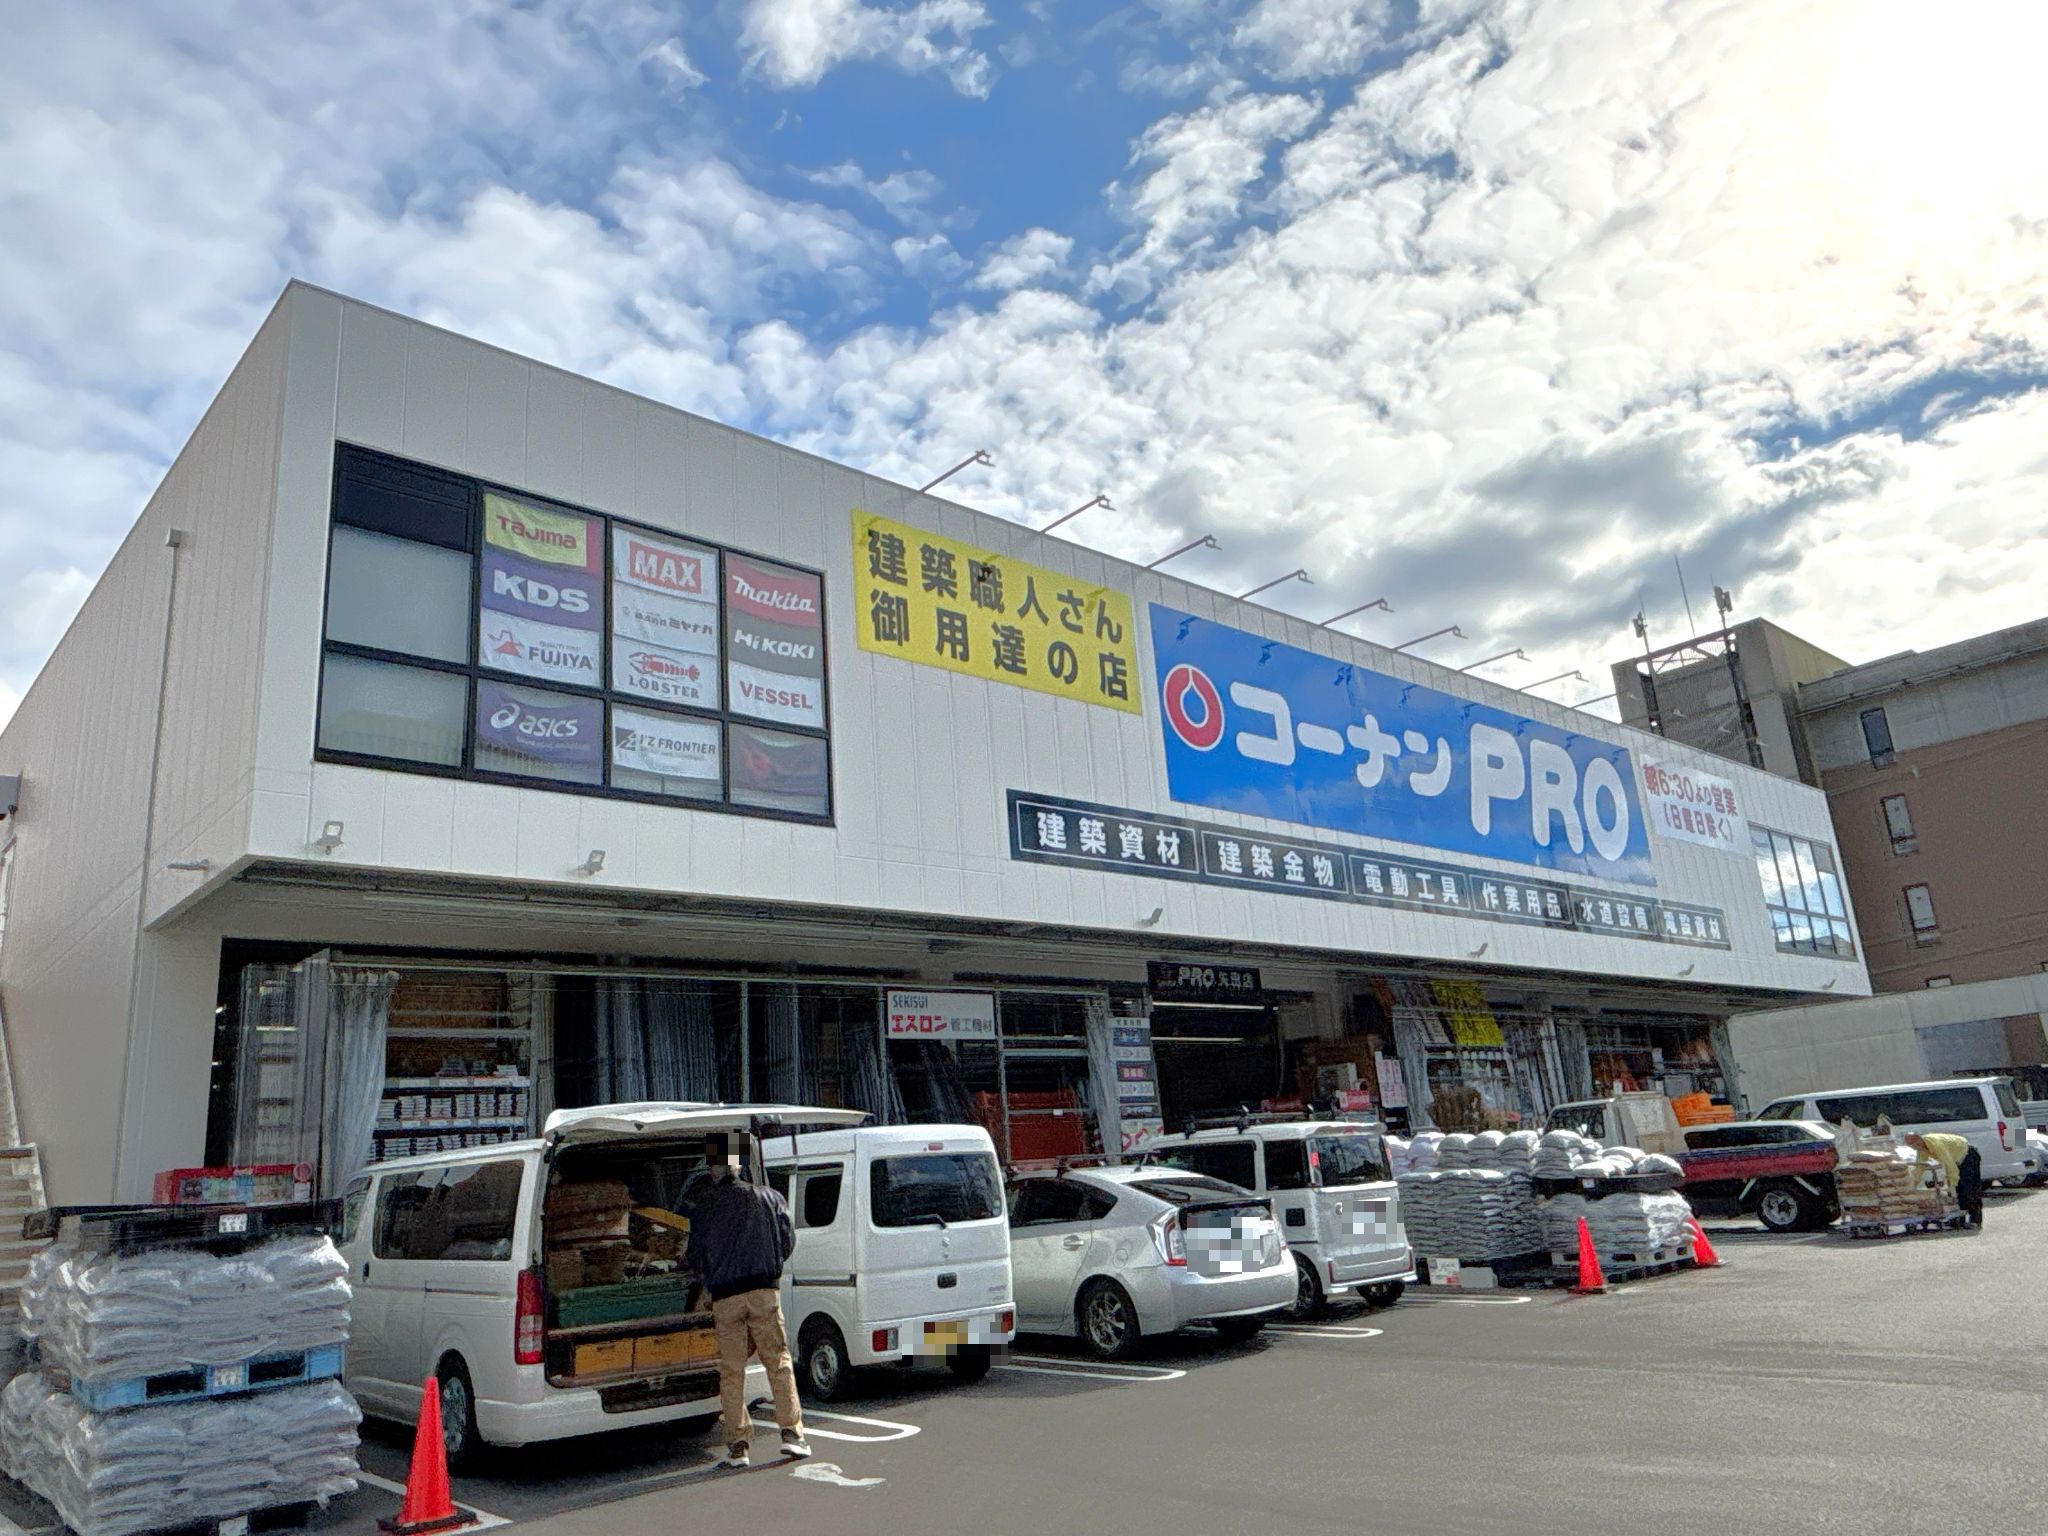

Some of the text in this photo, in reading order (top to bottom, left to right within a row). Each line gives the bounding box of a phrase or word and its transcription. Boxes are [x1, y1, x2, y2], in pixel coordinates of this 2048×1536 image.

[634, 550, 697, 587] MAX
[867, 527, 1124, 645] 建築職人さん
[493, 569, 590, 613] KDS
[528, 646, 593, 671] FUJIYA
[870, 588, 1129, 701] 御用達の店
[628, 674, 700, 699] LOBSTER
[739, 680, 814, 710] VESSEL
[518, 714, 579, 737] asics
[657, 738, 717, 755] FRONTIER
[1229, 680, 1630, 862] コーナン PRO
[1036, 811, 1181, 866] 建築資材
[1217, 840, 1336, 888] 建築金物
[1362, 863, 1459, 905] 電動工具
[1481, 880, 1563, 919] 作業用品
[1580, 897, 1649, 930] 水道設備
[892, 994, 929, 1009] SEKISUI
[891, 1014, 948, 1033] エスロン
